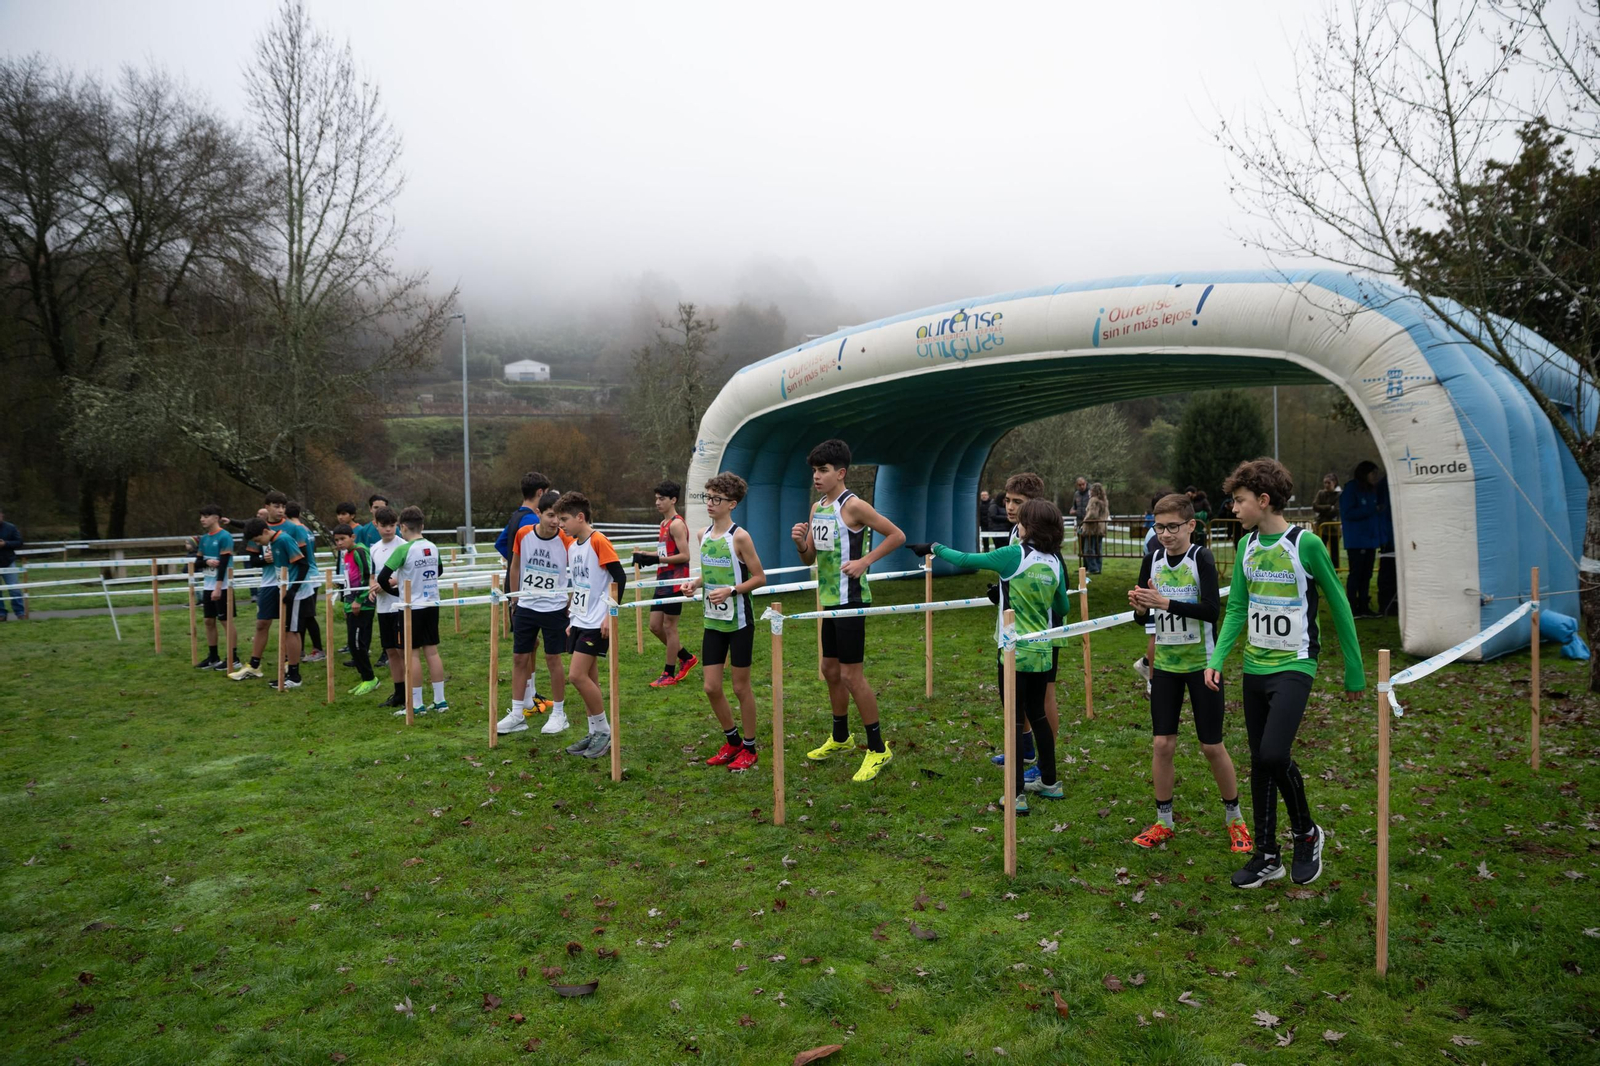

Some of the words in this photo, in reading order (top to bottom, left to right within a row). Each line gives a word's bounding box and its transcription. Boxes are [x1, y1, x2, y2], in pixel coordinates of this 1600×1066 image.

[1102, 328, 1120, 340] sin
[1122, 323, 1131, 335] ir
[1133, 316, 1158, 333] más
[1161, 309, 1192, 326] lejos
[1414, 460, 1468, 476] inorde
[812, 525, 829, 541] 112
[533, 548, 551, 559] ANA
[523, 574, 555, 590] 428
[1158, 613, 1187, 632] 111
[1251, 612, 1291, 637] 110
